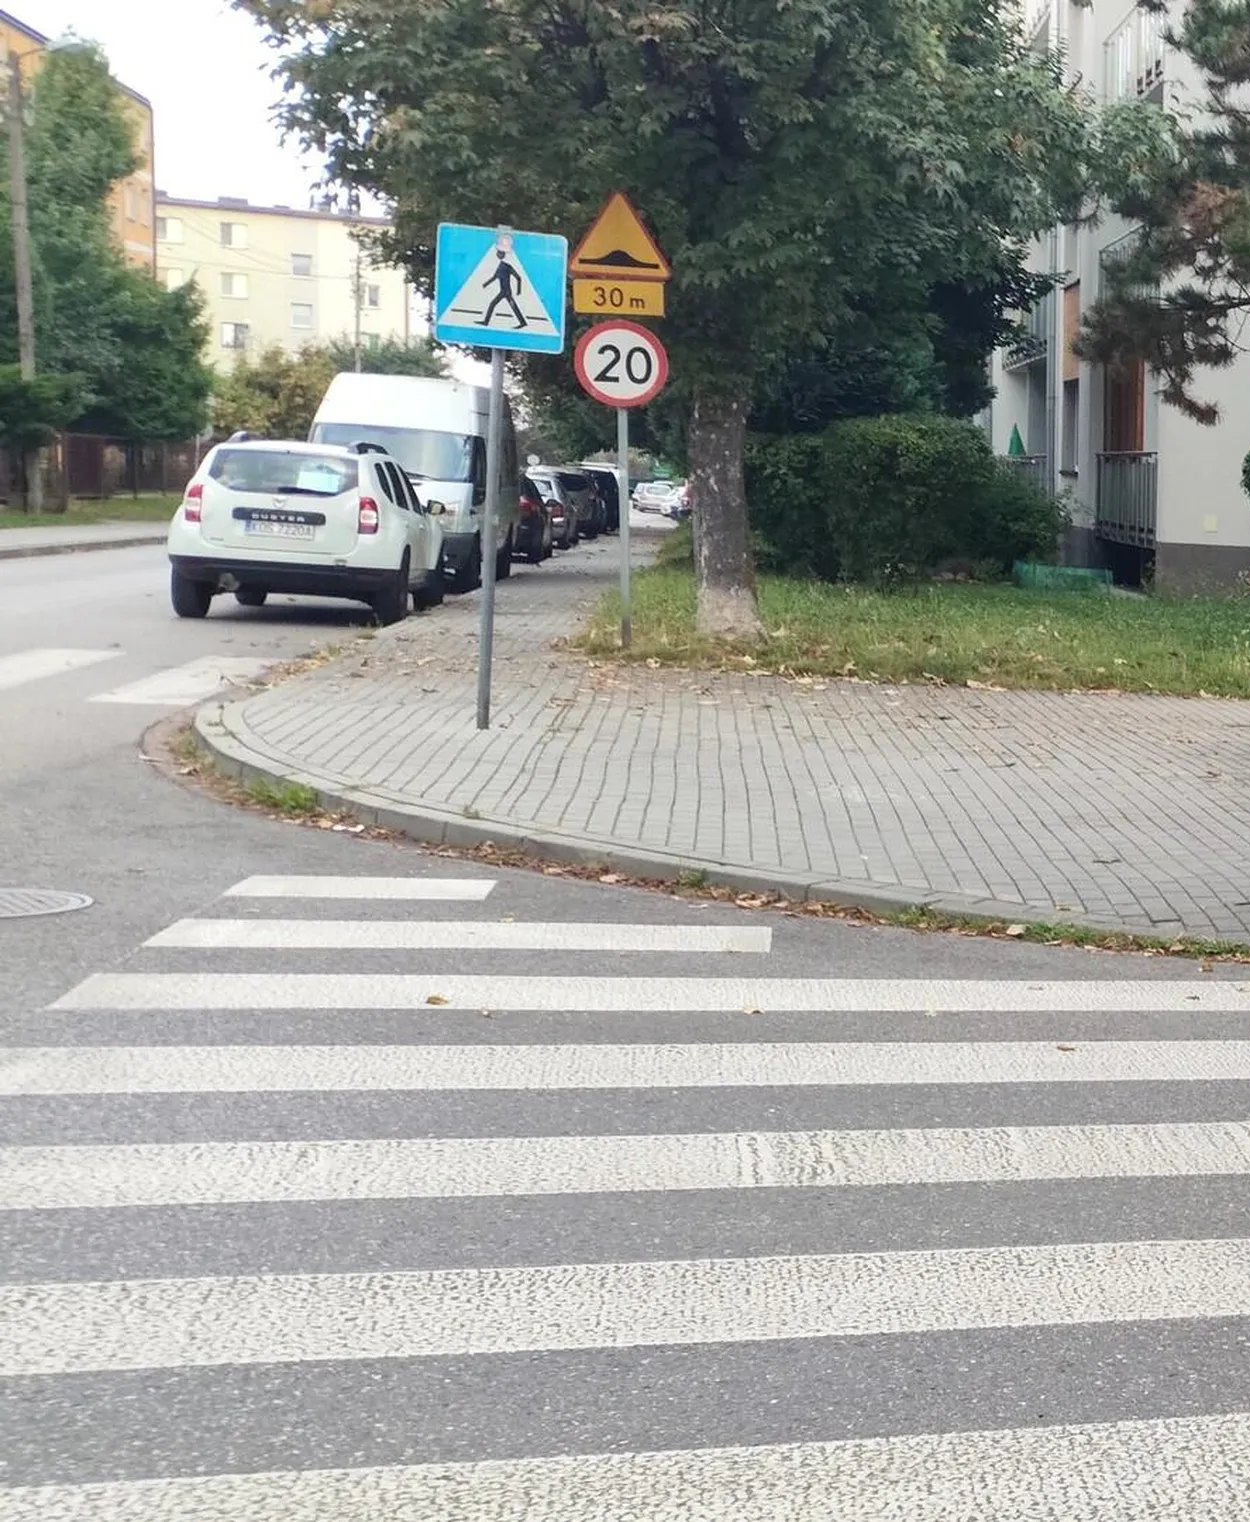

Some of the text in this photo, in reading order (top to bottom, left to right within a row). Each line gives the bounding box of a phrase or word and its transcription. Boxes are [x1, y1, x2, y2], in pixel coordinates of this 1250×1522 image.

[592, 286, 646, 310] 30 m
[593, 344, 653, 385] 20
[251, 512, 306, 523] DUSTER
